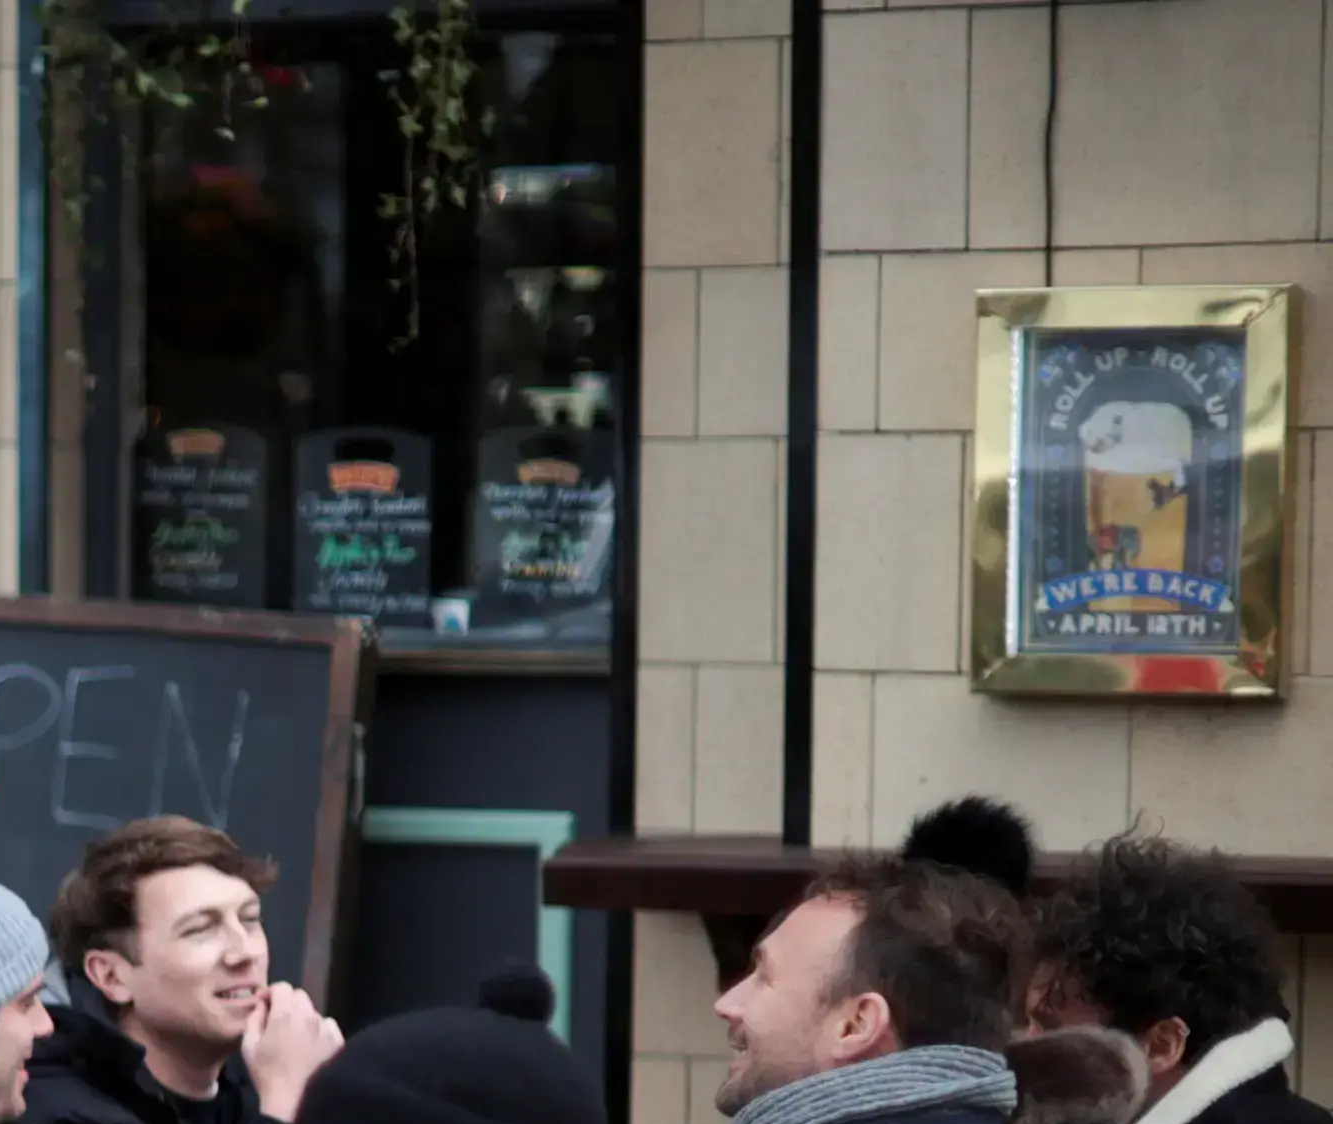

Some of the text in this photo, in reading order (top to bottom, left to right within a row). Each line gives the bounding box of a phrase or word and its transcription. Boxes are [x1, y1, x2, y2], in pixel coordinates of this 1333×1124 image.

[1049, 345, 1229, 431] ROLL UP ROLL UP
[1049, 572, 1219, 605] WE'RE BACK
[1059, 612, 1140, 635] APRIL
